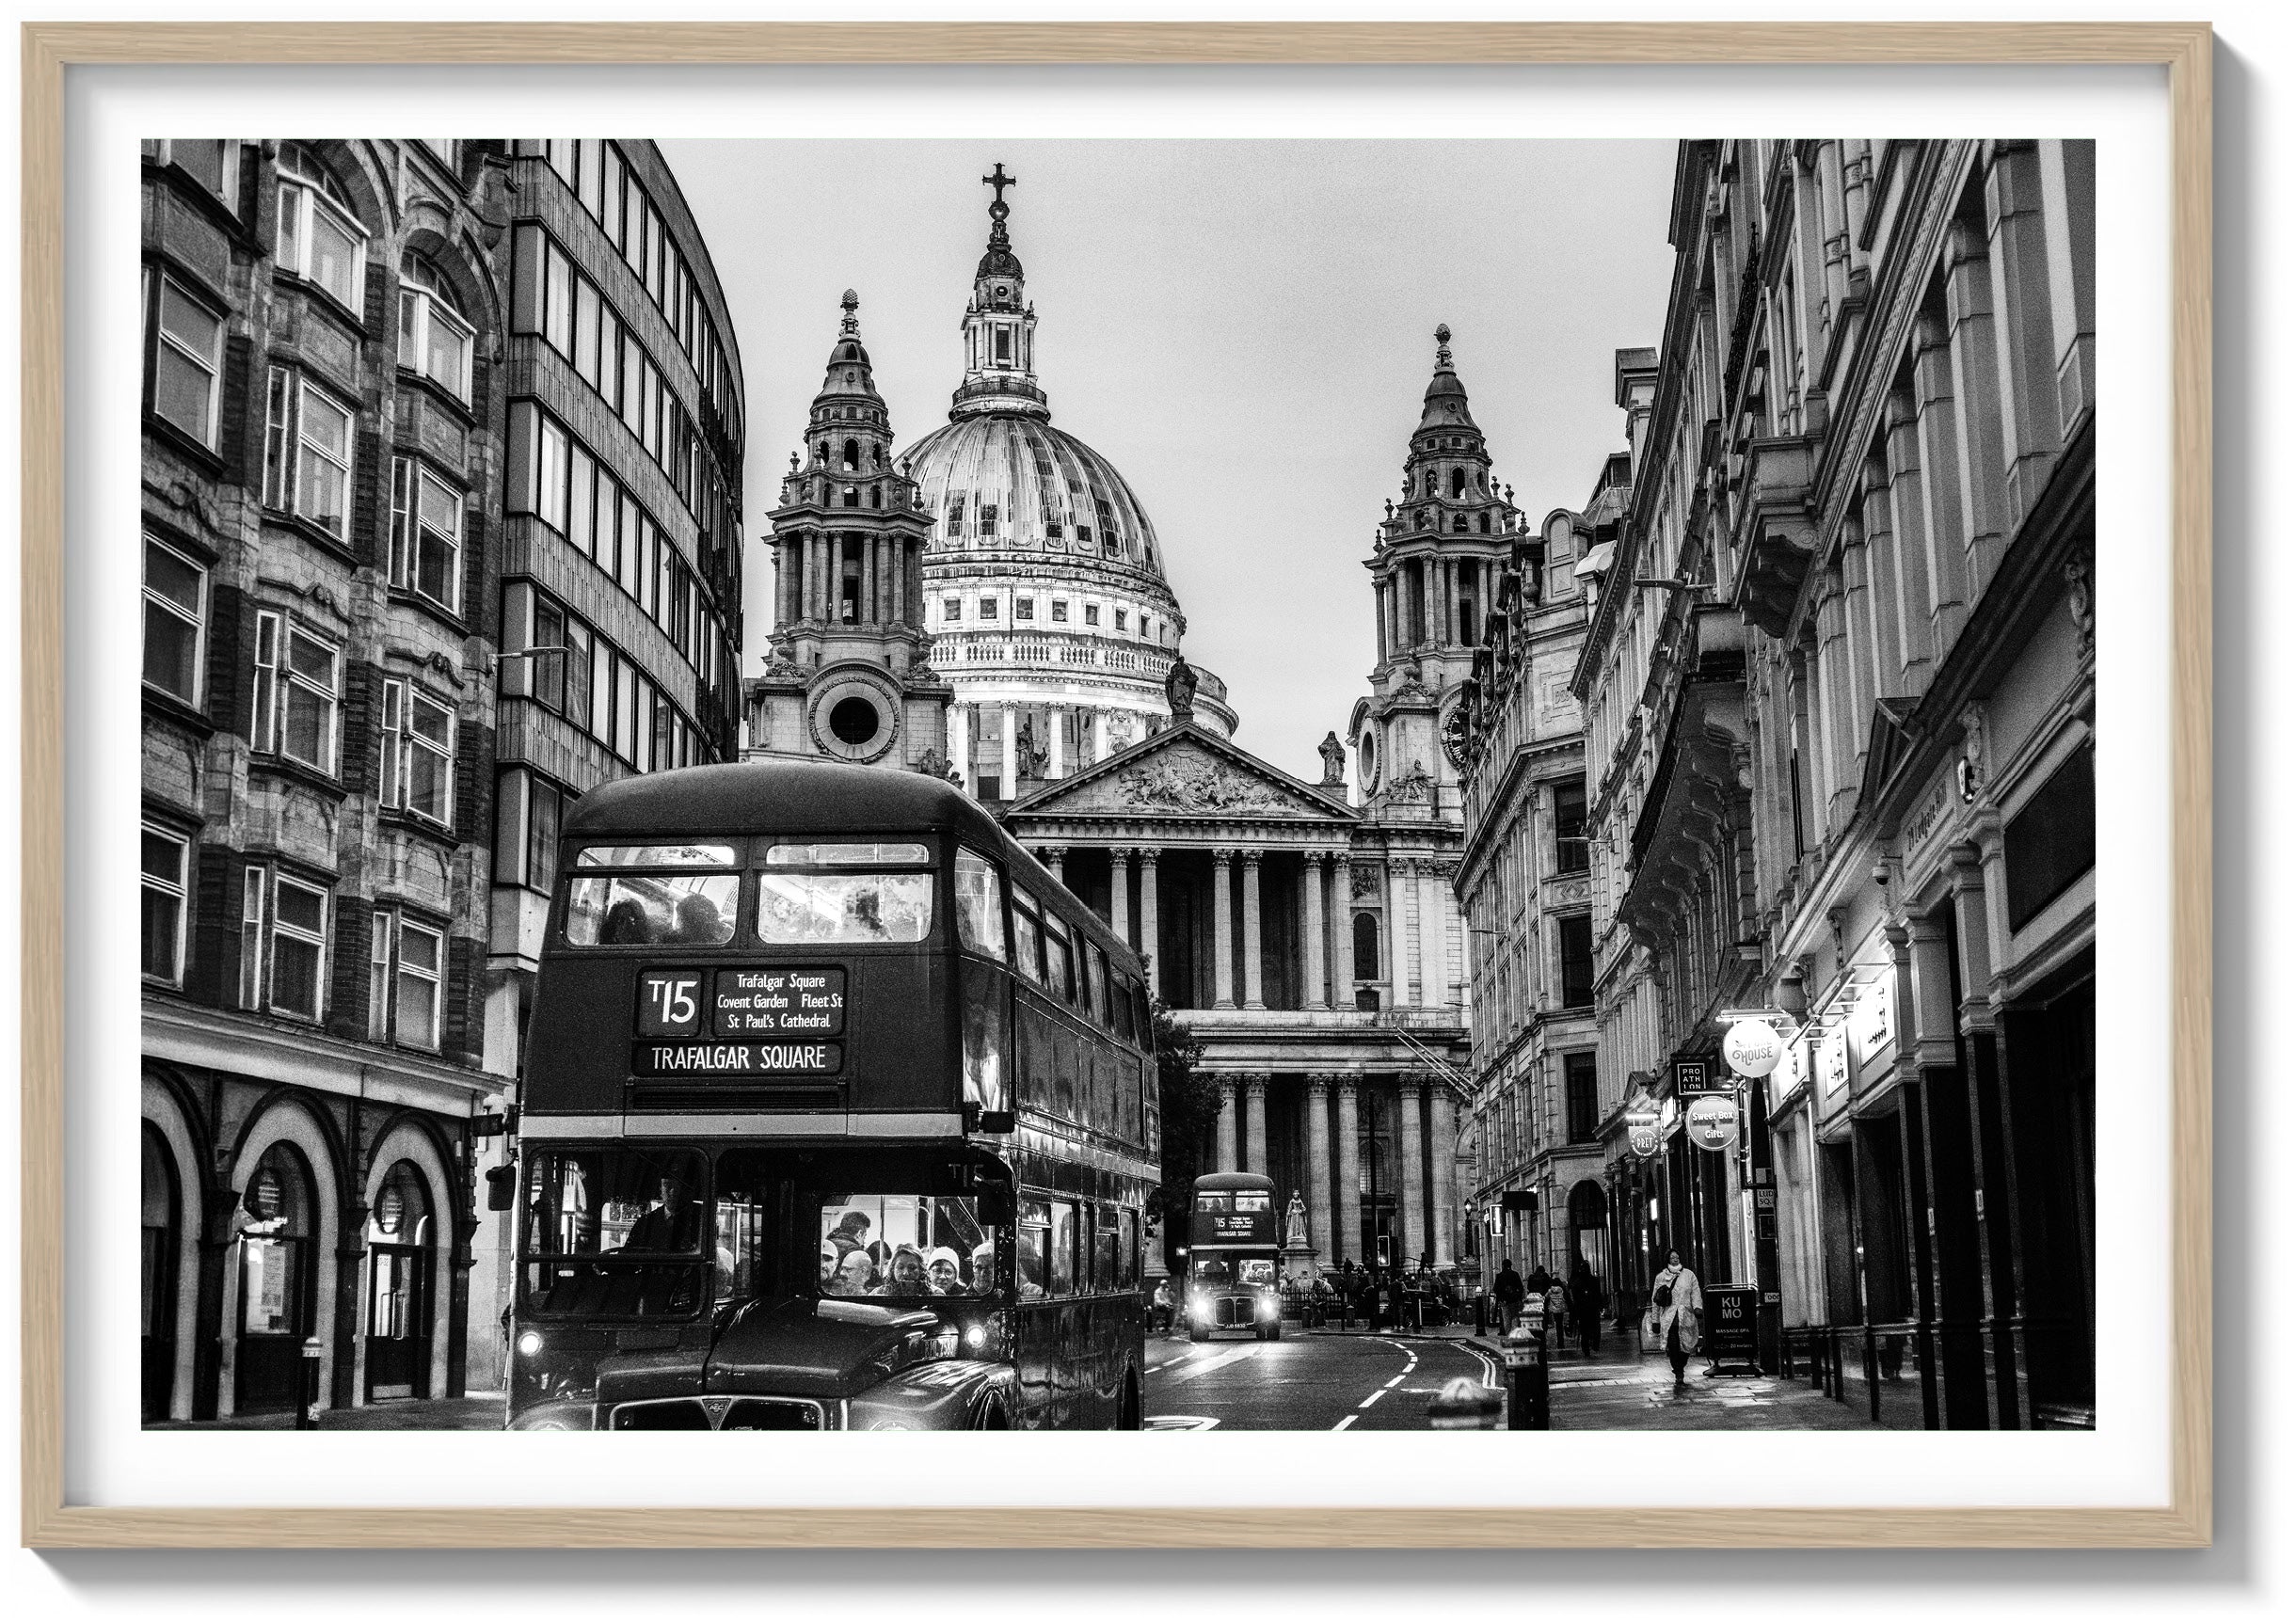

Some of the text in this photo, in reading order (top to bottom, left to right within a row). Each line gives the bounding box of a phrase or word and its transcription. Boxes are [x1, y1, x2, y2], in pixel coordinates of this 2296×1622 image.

[737, 974, 825, 991] Trafalgar Square
[647, 980, 698, 1023] T15
[717, 994, 843, 1008] Covent Garden Fleet St
[727, 1013, 831, 1028] St Paul's Cathedral
[651, 1045, 826, 1070] TRAFALGAR SQUARE
[1718, 1111, 1733, 1120] Box
[1704, 1129, 1725, 1138] Gifts
[1637, 1137, 1652, 1148] PRET
[1722, 1296, 1741, 1308] KU
[1722, 1309, 1742, 1318] MO
